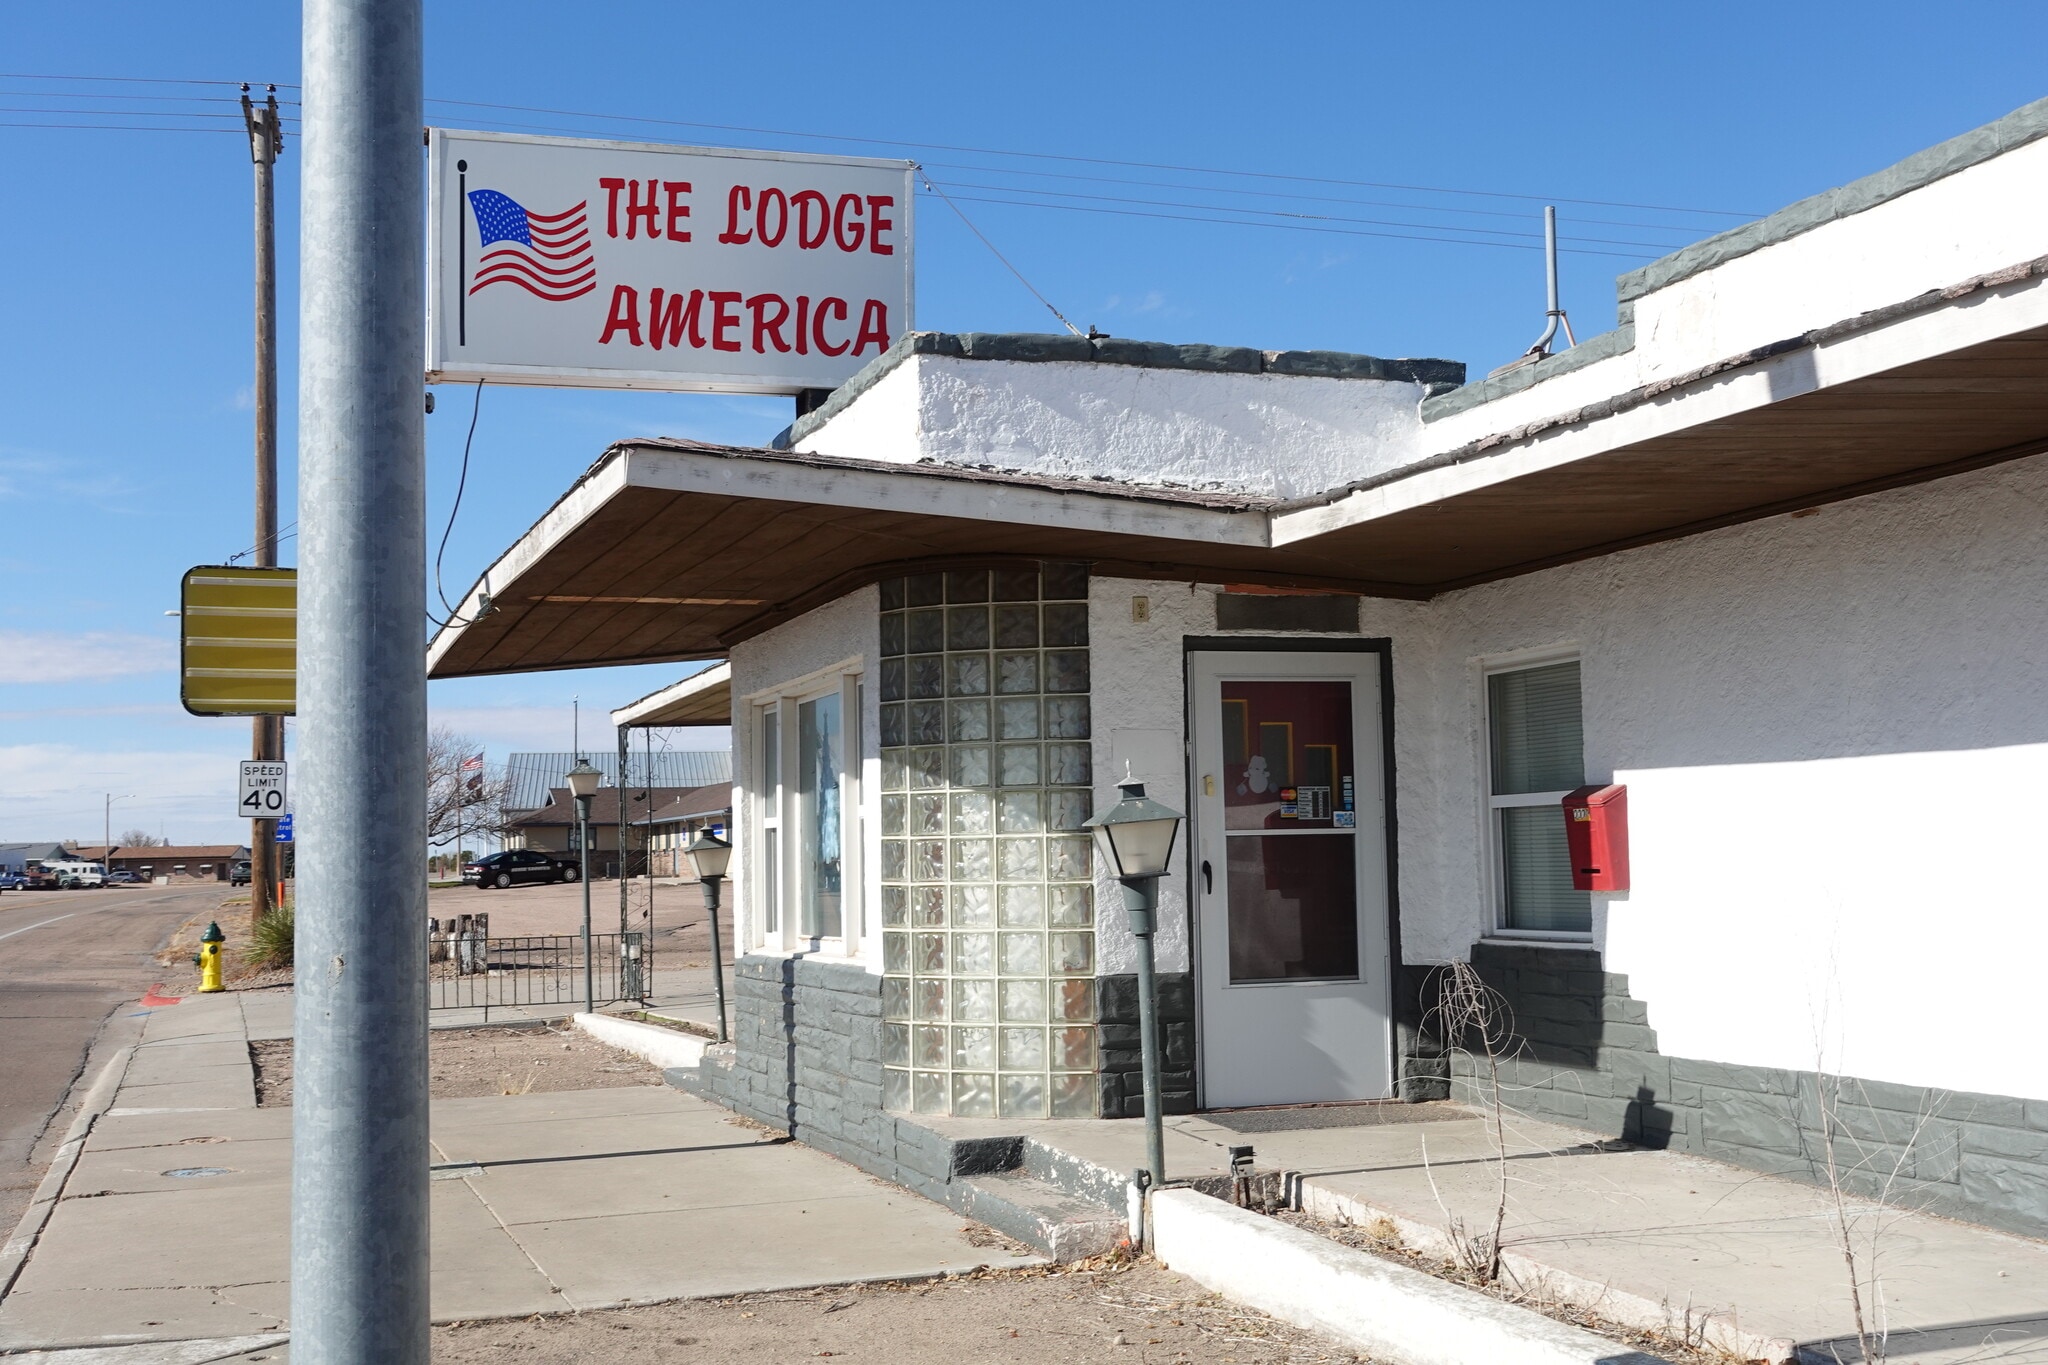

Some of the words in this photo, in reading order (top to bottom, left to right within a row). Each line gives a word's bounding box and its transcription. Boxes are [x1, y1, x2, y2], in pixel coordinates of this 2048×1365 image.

[599, 177, 692, 243] THE
[718, 184, 894, 256] LODGE
[598, 284, 891, 357] AMERICA
[244, 766, 283, 776] SPEED
[248, 778, 279, 787] LIMIT
[243, 790, 283, 810] 40
